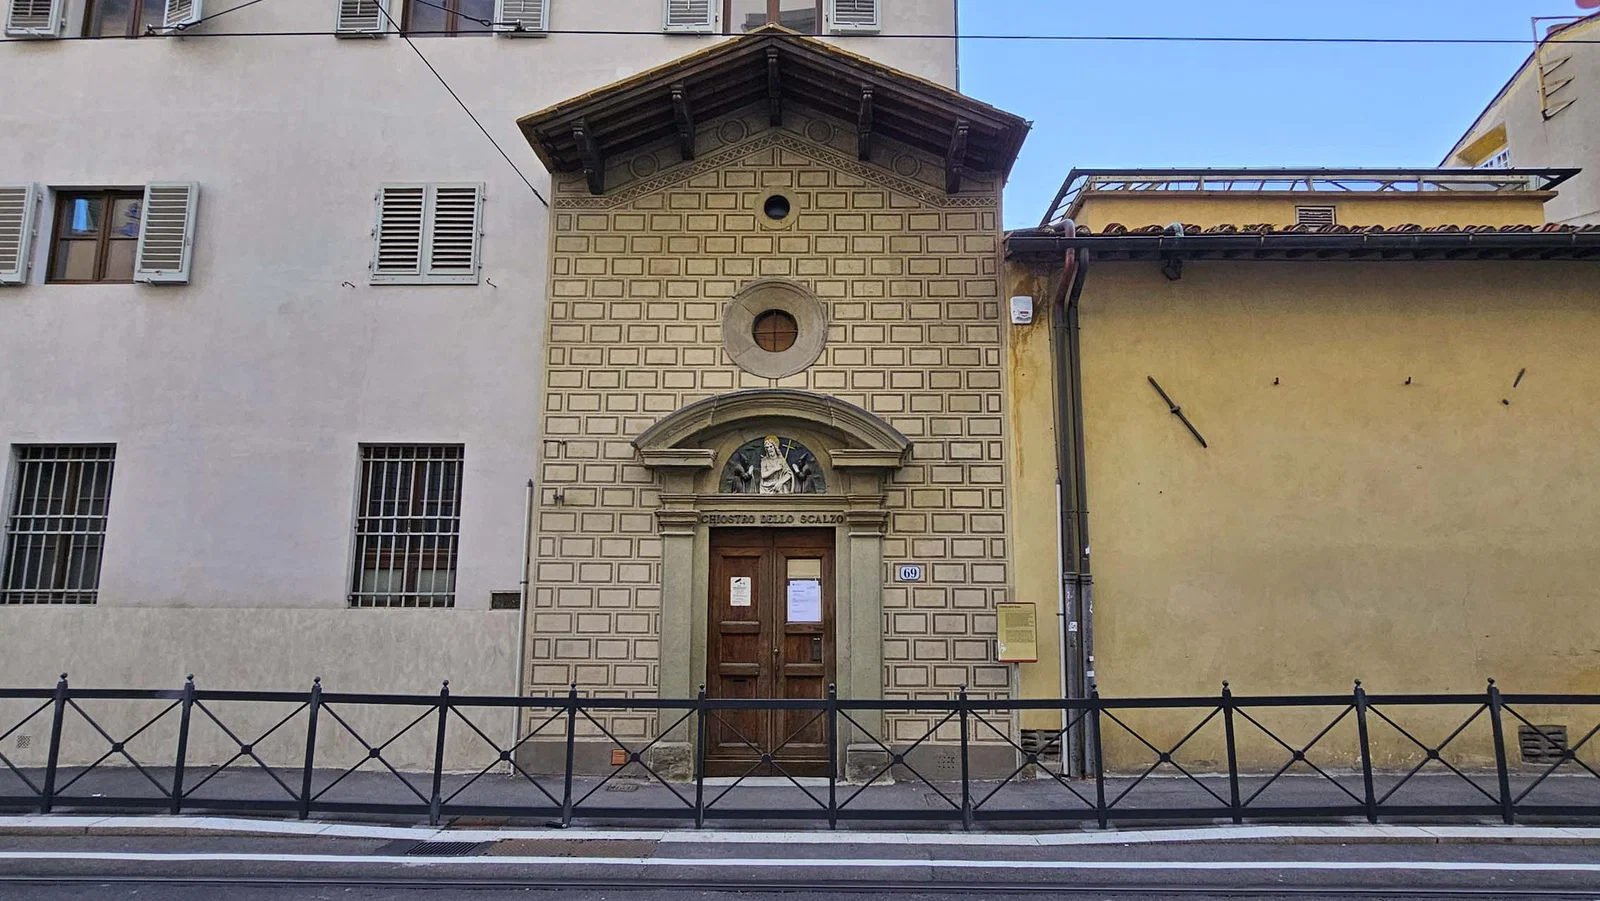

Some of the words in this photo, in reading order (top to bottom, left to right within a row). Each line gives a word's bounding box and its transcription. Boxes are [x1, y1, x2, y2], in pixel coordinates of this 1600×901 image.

[701, 514, 756, 524] CHIOSTRO
[760, 514, 794, 524] DELLO
[800, 514, 844, 524] SCALZO
[903, 568, 917, 579] 69
